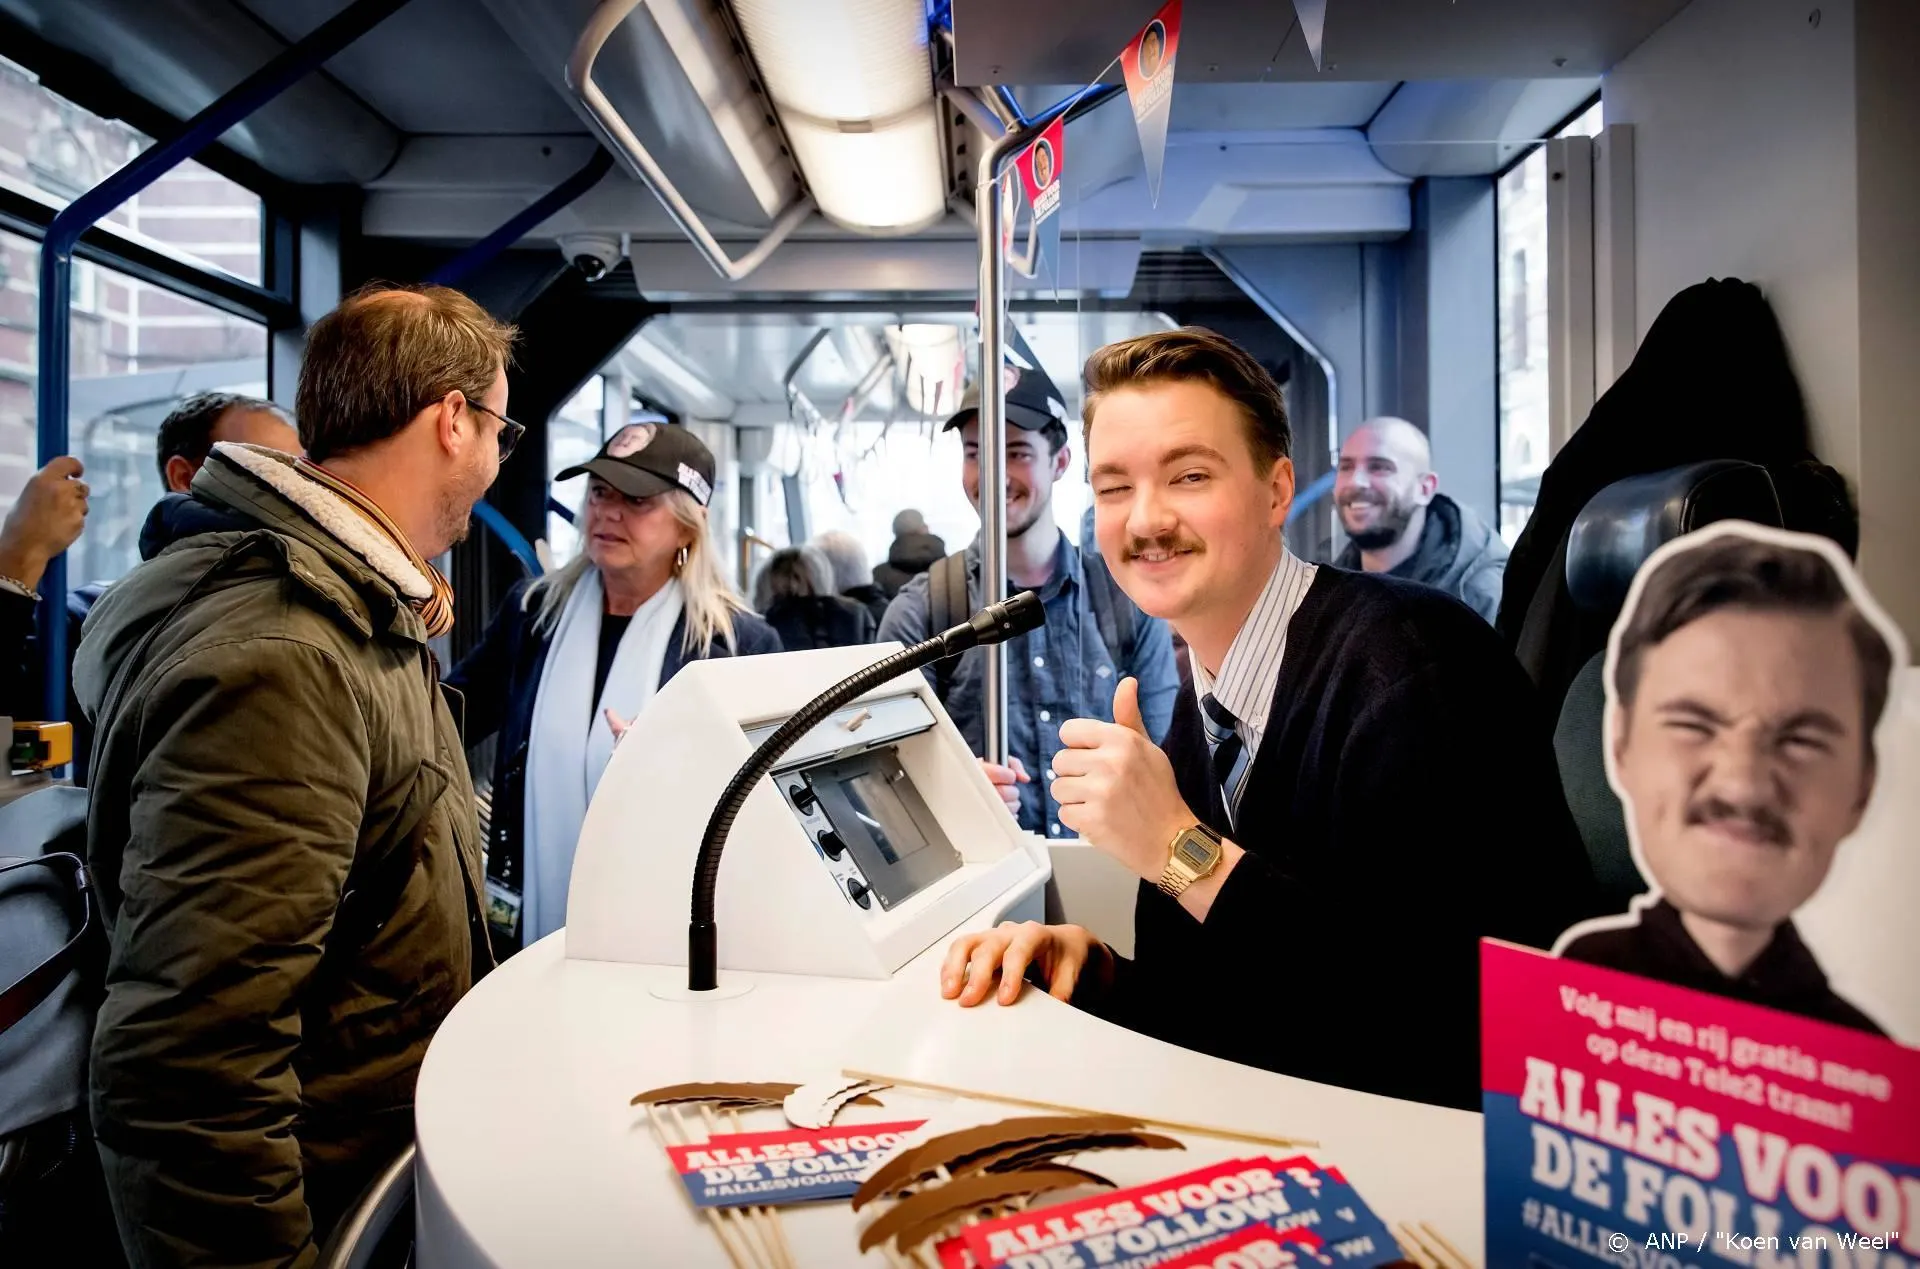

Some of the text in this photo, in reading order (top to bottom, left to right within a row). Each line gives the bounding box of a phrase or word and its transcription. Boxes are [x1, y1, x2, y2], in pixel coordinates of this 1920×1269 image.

[1559, 985, 1893, 1102] Volg mij en rij gratis mee
[1586, 1033, 1854, 1132] op deze Tele2 tram!
[685, 1132, 904, 1170] ALLES VOO
[1520, 1057, 1720, 1180] ALLES
[701, 1164, 763, 1185] DE
[704, 1171, 860, 1198] #ALLESVOORD
[1531, 1122, 1612, 1209] DE
[985, 1200, 1144, 1261] ALLES
[1141, 1168, 1285, 1218] VOOR
[1083, 1189, 1291, 1264] FOLLOW
